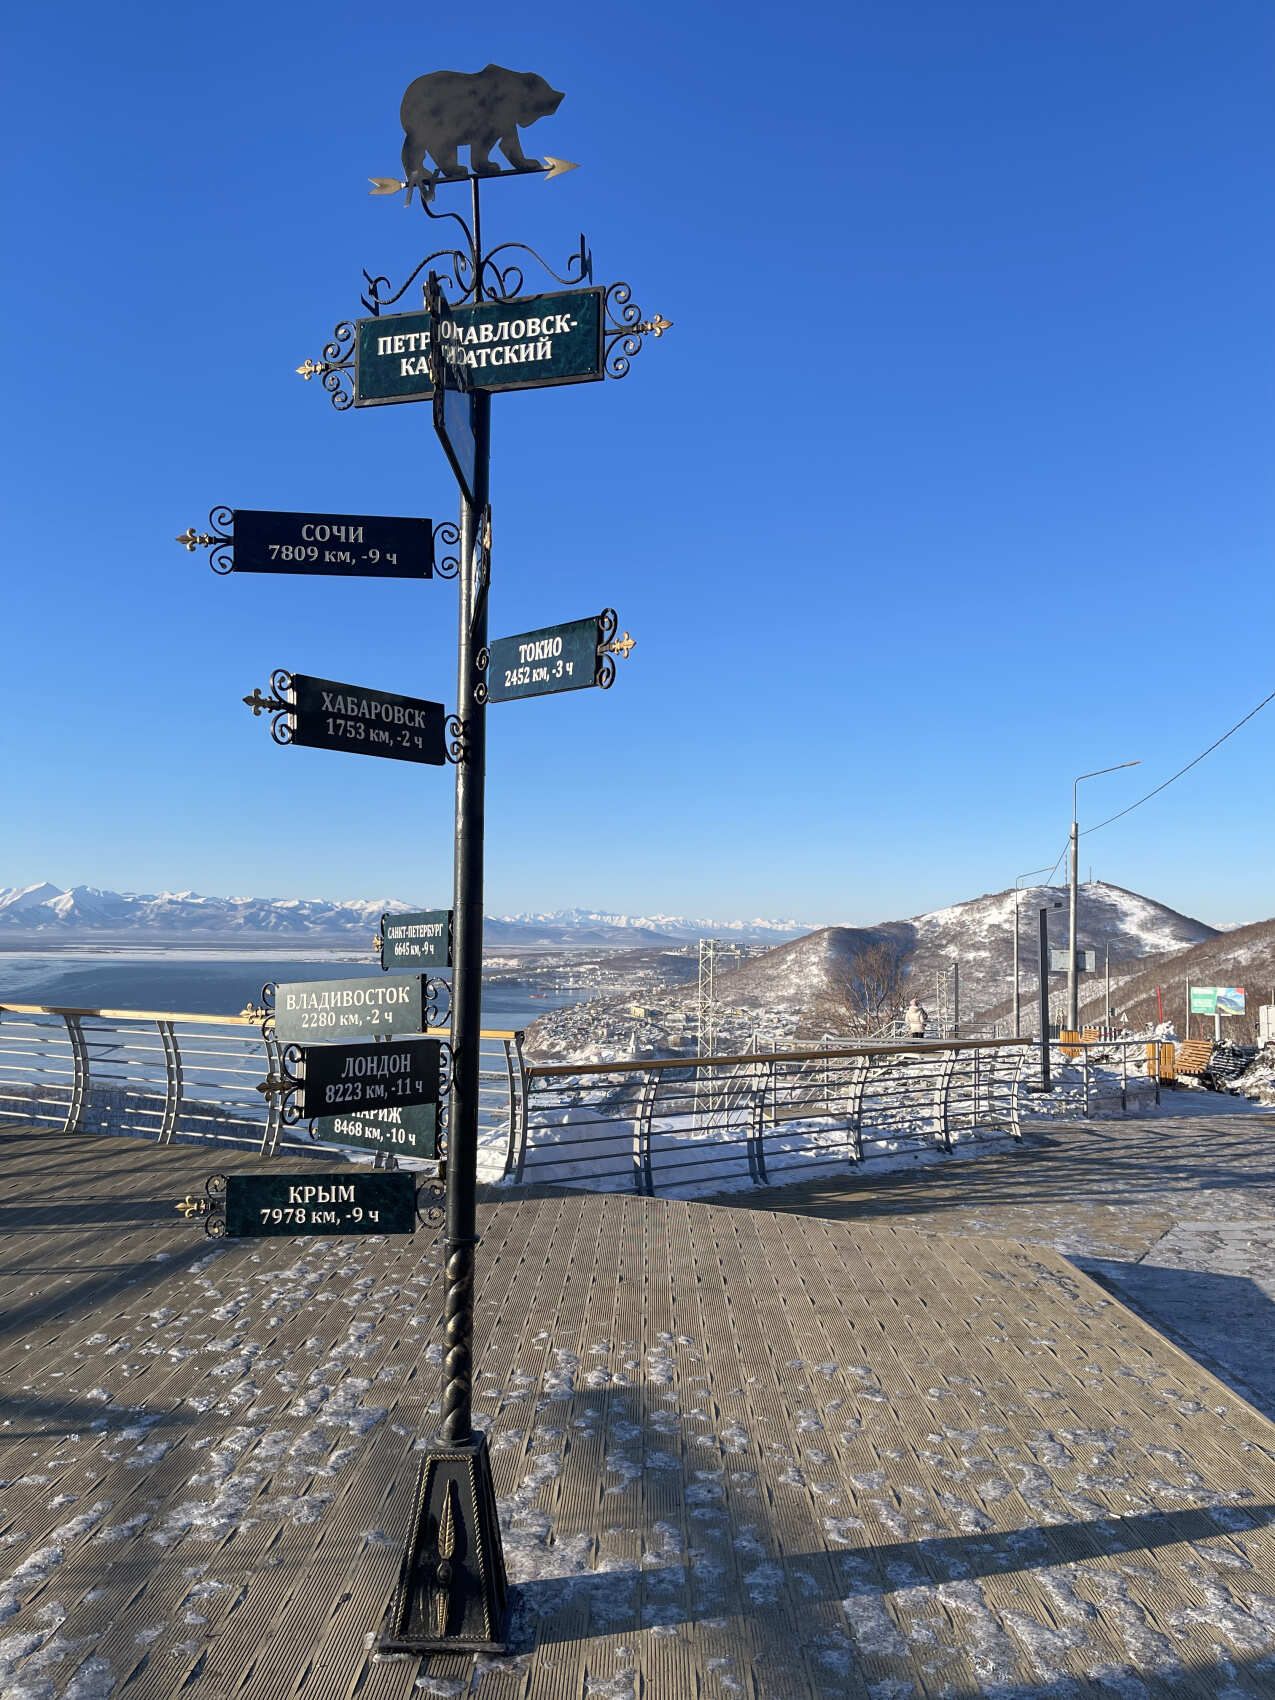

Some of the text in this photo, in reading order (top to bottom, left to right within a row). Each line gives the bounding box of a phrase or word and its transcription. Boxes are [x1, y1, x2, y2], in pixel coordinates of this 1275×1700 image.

[377, 313, 578, 356] ПЕТРАВЛОВСК-
[400, 335, 553, 377] КААТСКИЙ
[301, 524, 364, 543] СОЧИ
[268, 544, 397, 566] 7809 км, -9 ч
[519, 637, 563, 663] ТОКИО
[504, 660, 574, 687] 2452 км, -3 ч
[321, 691, 426, 729] ХАБАРОВСК
[326, 718, 423, 749] 1753 км, -2 ч
[387, 923, 444, 939] САНКТ-ПЕТЕРБУРГ
[410, 945, 421, 957] км,
[422, 941, 429, 955] -9
[286, 986, 410, 1012] ВЛАДИВОСТОК
[301, 1009, 393, 1028] 2280 км, -2 ч
[341, 1053, 412, 1079] ЛОНДОН
[325, 1078, 423, 1103] 8223 км, -11 ч
[351, 1107, 403, 1124] РИЖ
[334, 1118, 416, 1146] 8468 км, -10 ч
[288, 1185, 356, 1203] КРЫМ
[260, 1207, 379, 1226] 7978 км, -9 ч
